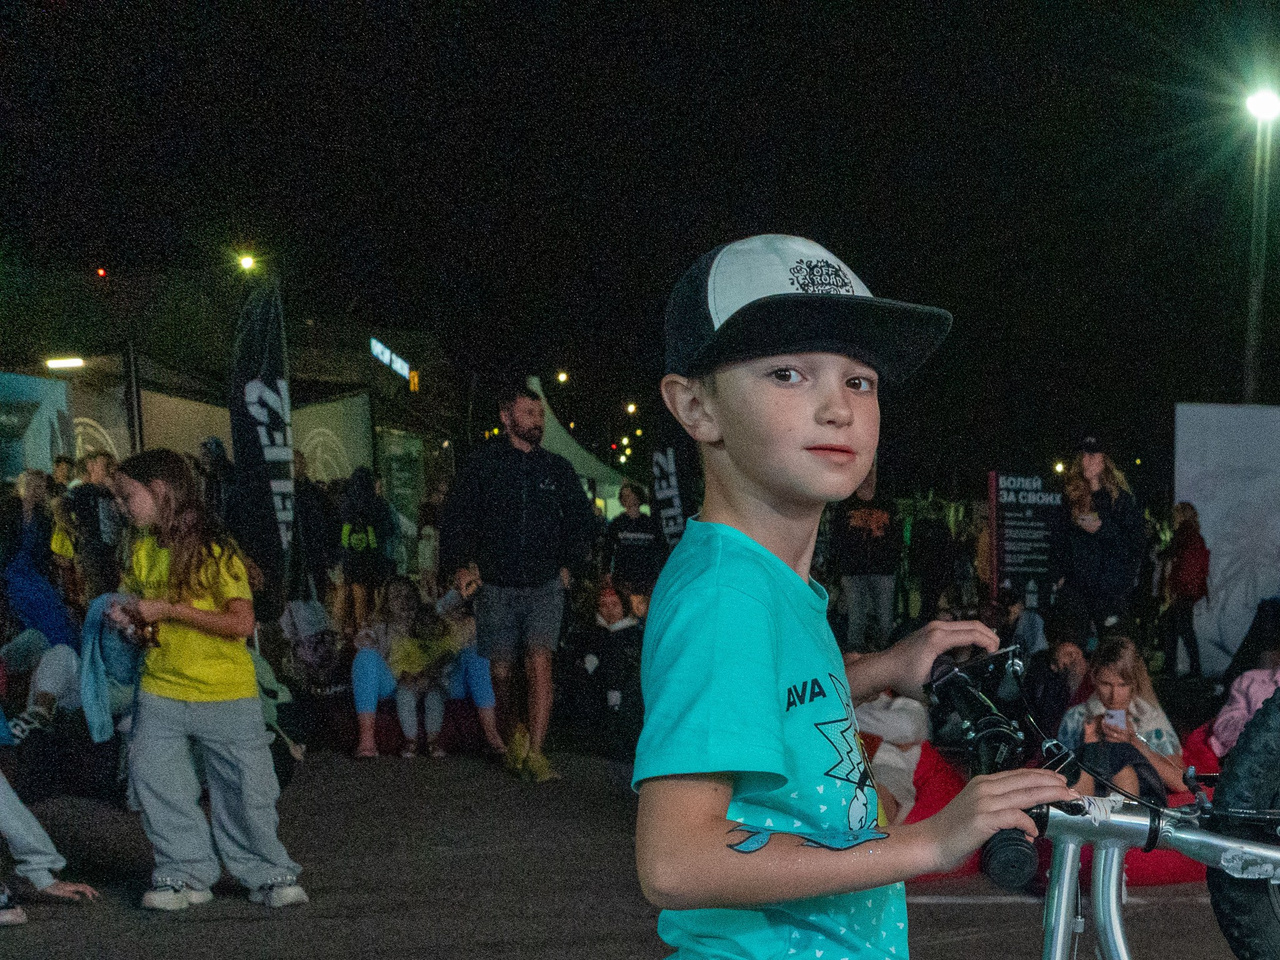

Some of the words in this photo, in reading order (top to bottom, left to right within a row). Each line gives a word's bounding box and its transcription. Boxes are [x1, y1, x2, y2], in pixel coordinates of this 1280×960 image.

[813, 266, 836, 277] OFF
[812, 275, 843, 287] ROAD
[999, 475, 1042, 491] БОЛЕЙ
[999, 490, 1016, 503] ЗА
[1018, 491, 1062, 506] СВОИХ
[785, 678, 827, 712] AVA
